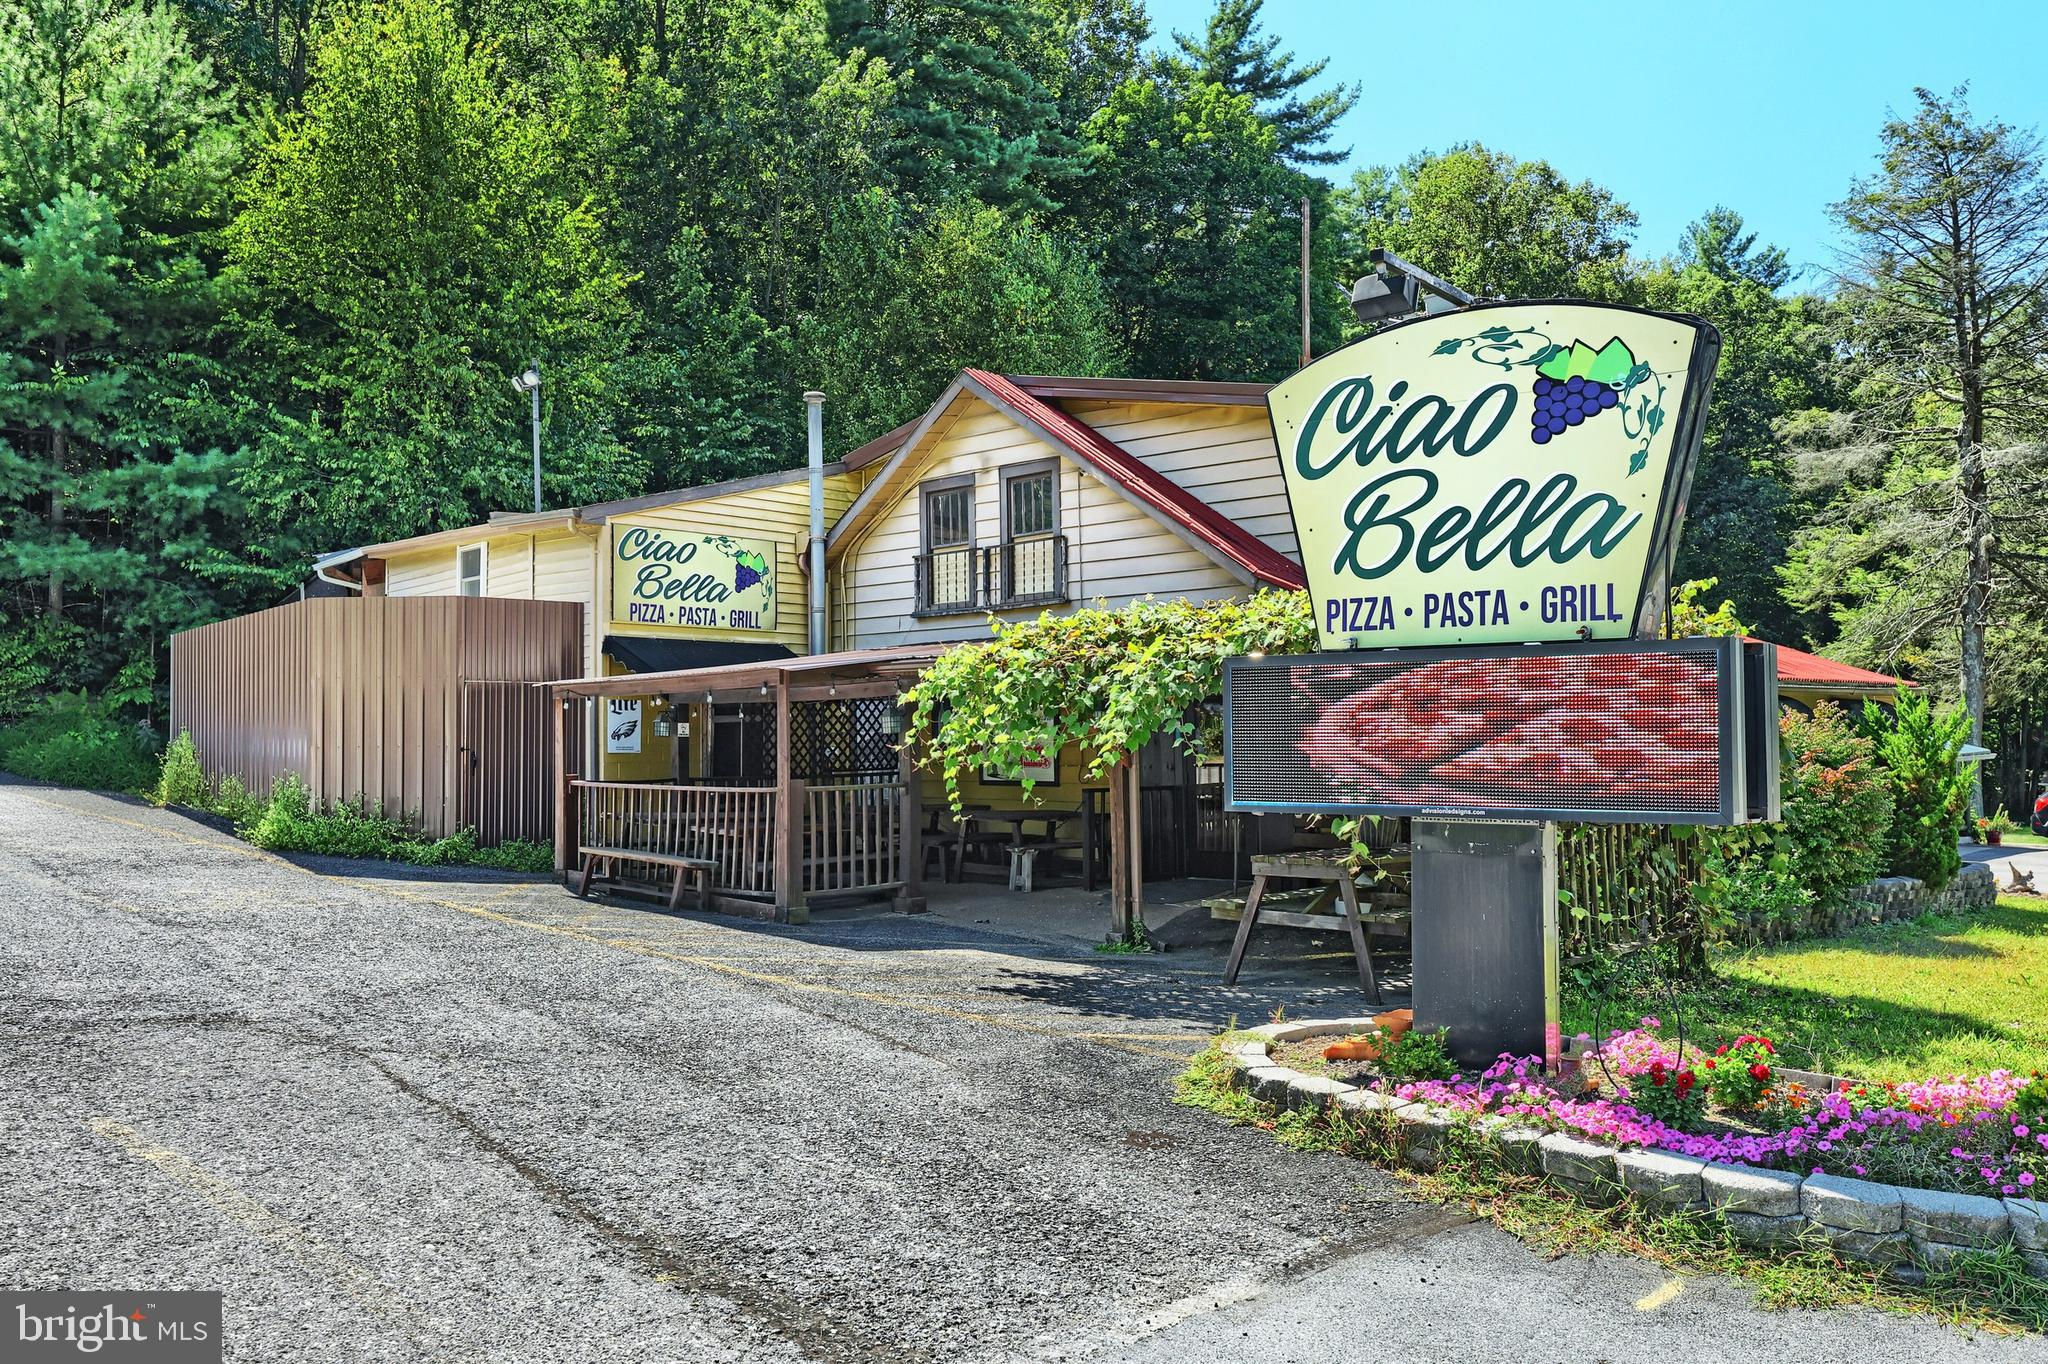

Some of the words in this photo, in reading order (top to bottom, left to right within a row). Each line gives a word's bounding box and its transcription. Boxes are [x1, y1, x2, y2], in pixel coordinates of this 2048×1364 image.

[1294, 374, 1519, 481] Ciao
[618, 527, 697, 564] Ciao
[1331, 467, 1643, 580] Bella
[633, 563, 733, 603] Bella
[630, 602, 665, 623] PIZZA
[678, 606, 717, 626] PASTA
[730, 609, 761, 629] GRILL
[1326, 595, 1395, 633] PIZZA
[1423, 589, 1510, 629] PASTA
[1540, 583, 1623, 624] GRILL
